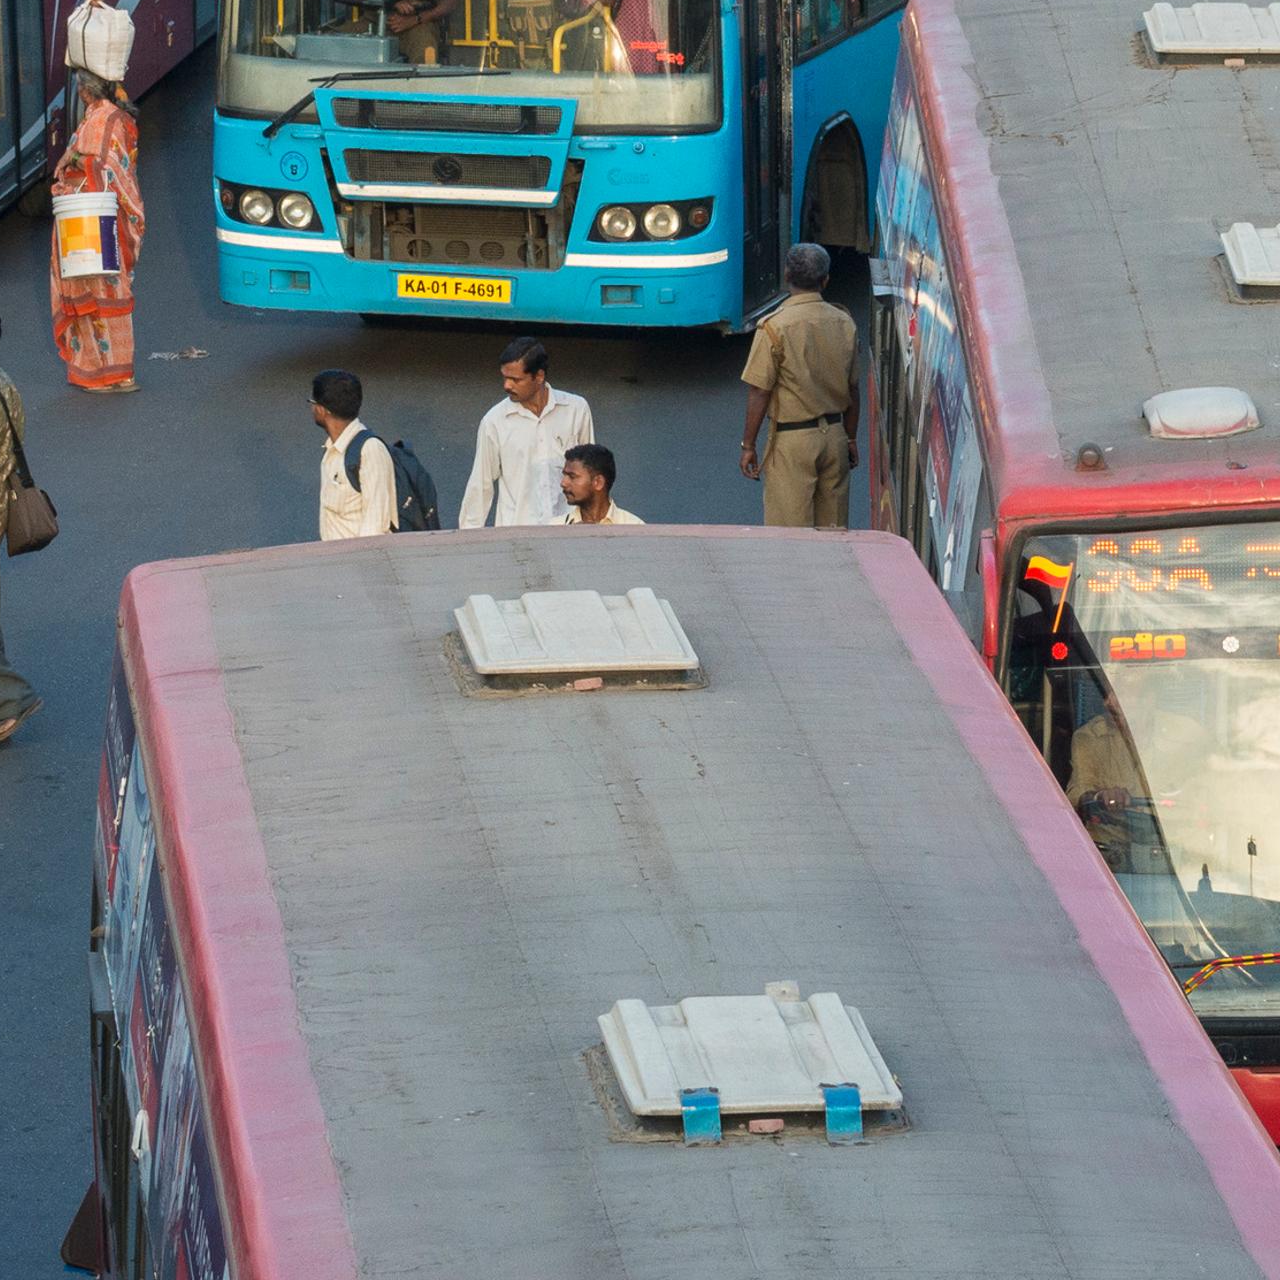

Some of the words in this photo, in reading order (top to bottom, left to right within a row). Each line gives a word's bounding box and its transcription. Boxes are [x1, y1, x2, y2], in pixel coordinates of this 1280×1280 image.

[405, 279, 451, 297] KA-01
[452, 280, 503, 300] F-4691
[1109, 633, 1187, 659] ಬೆಂ
